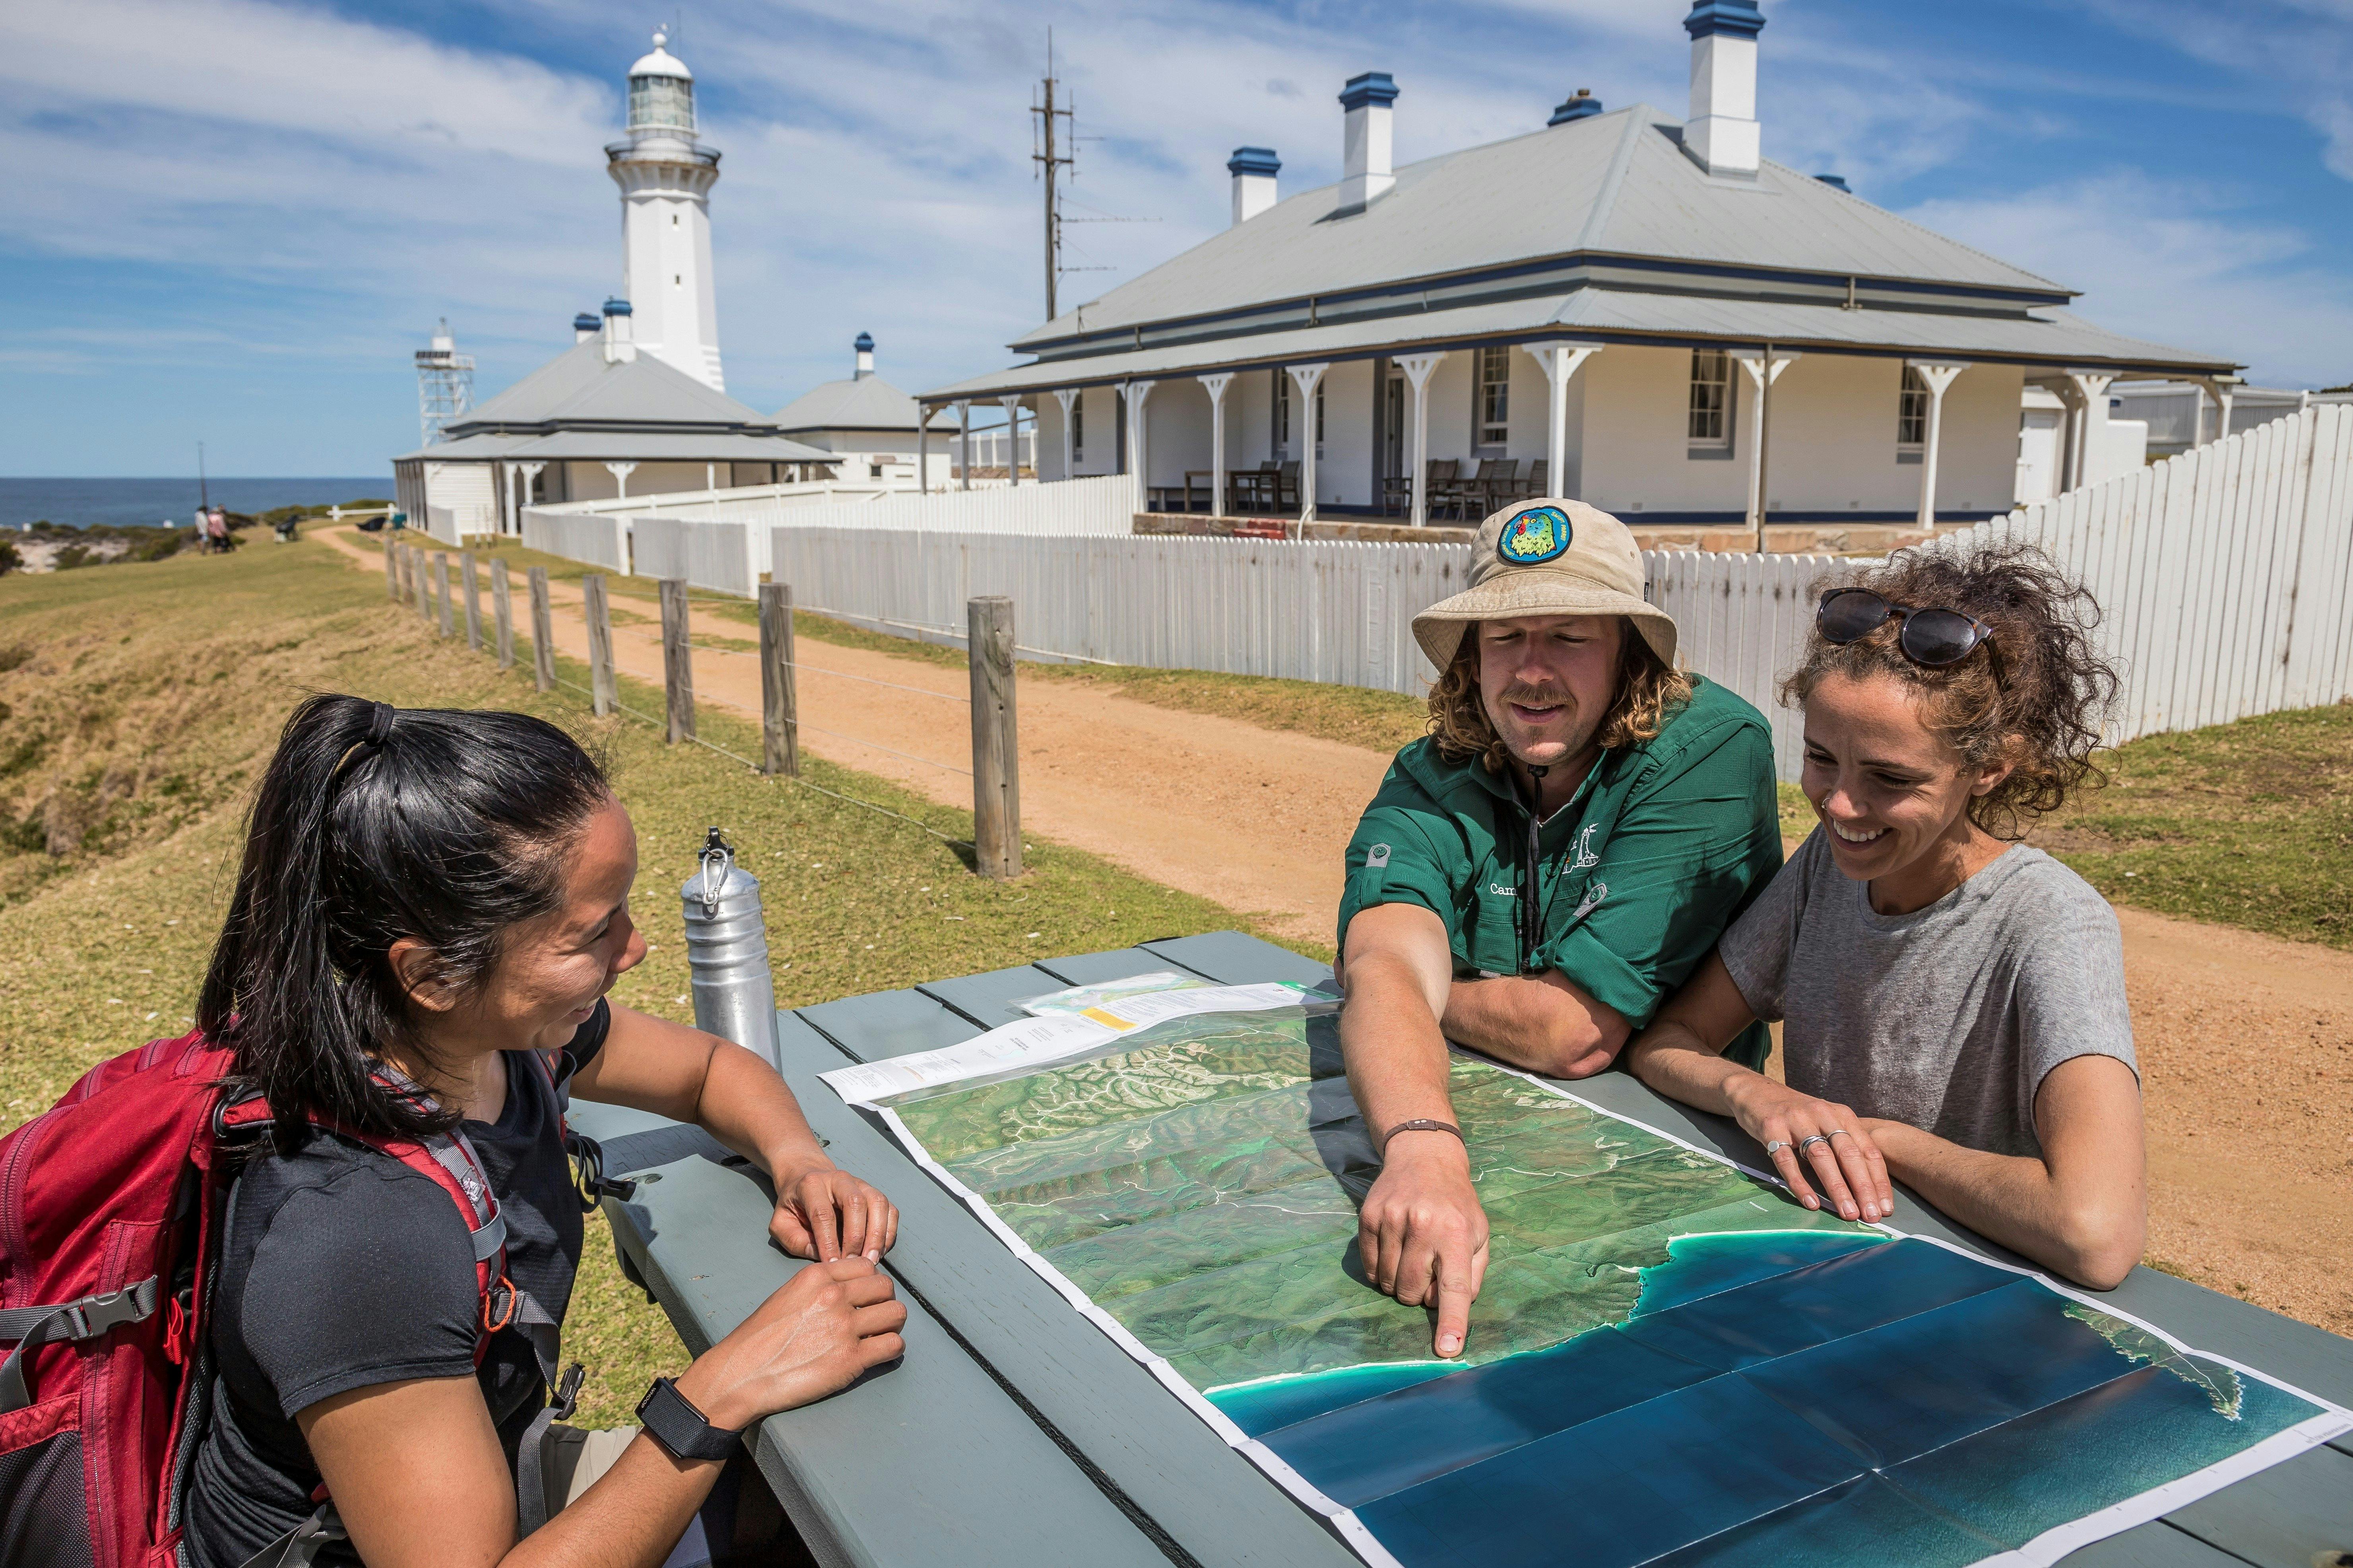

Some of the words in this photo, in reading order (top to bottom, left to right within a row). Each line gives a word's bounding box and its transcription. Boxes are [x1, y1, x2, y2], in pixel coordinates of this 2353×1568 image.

[1551, 511, 1565, 523] SWIFT
[1490, 883, 1517, 895] Cam
[642, 1388, 656, 1408] WHOOP
